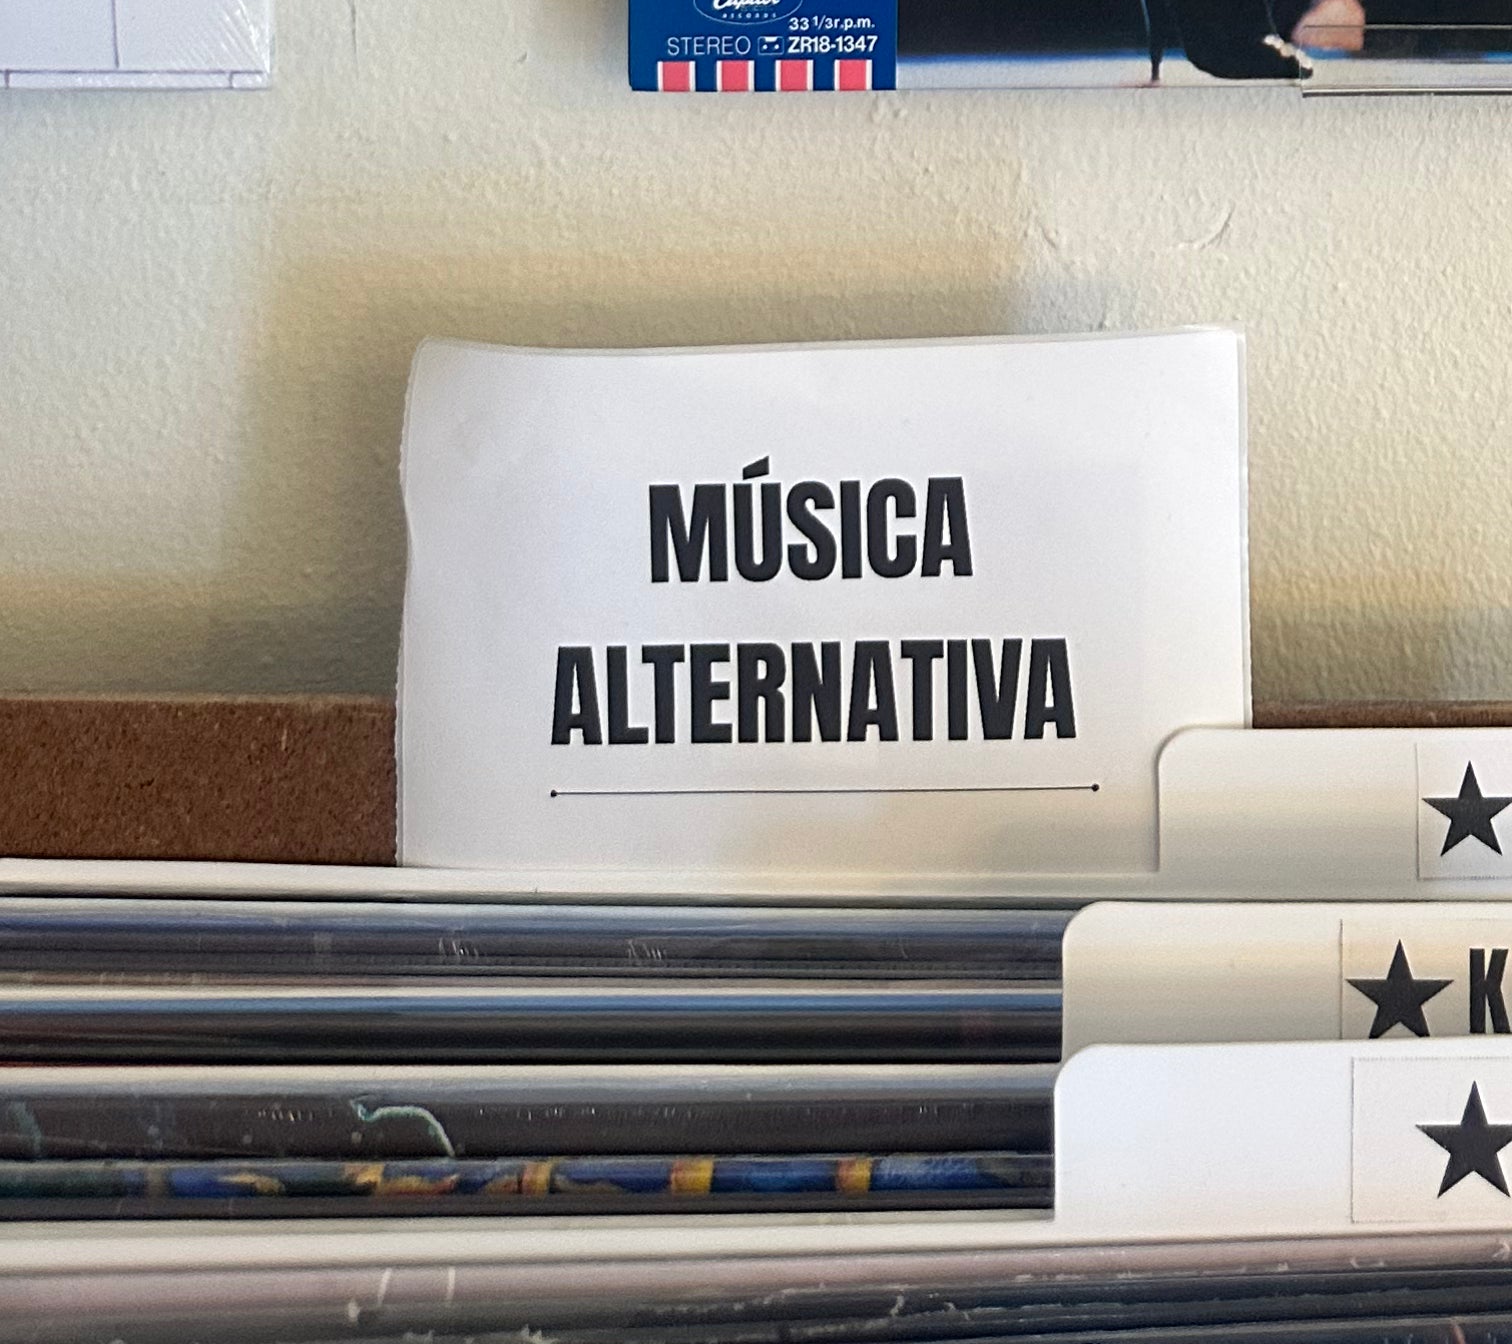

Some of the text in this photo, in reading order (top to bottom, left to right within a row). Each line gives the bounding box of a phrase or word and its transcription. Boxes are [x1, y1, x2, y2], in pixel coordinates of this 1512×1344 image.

[666, 34, 879, 56] STEREO ZR18-1347
[648, 455, 974, 584] MÚSICA
[550, 636, 1077, 746] ALTERNATIVA
